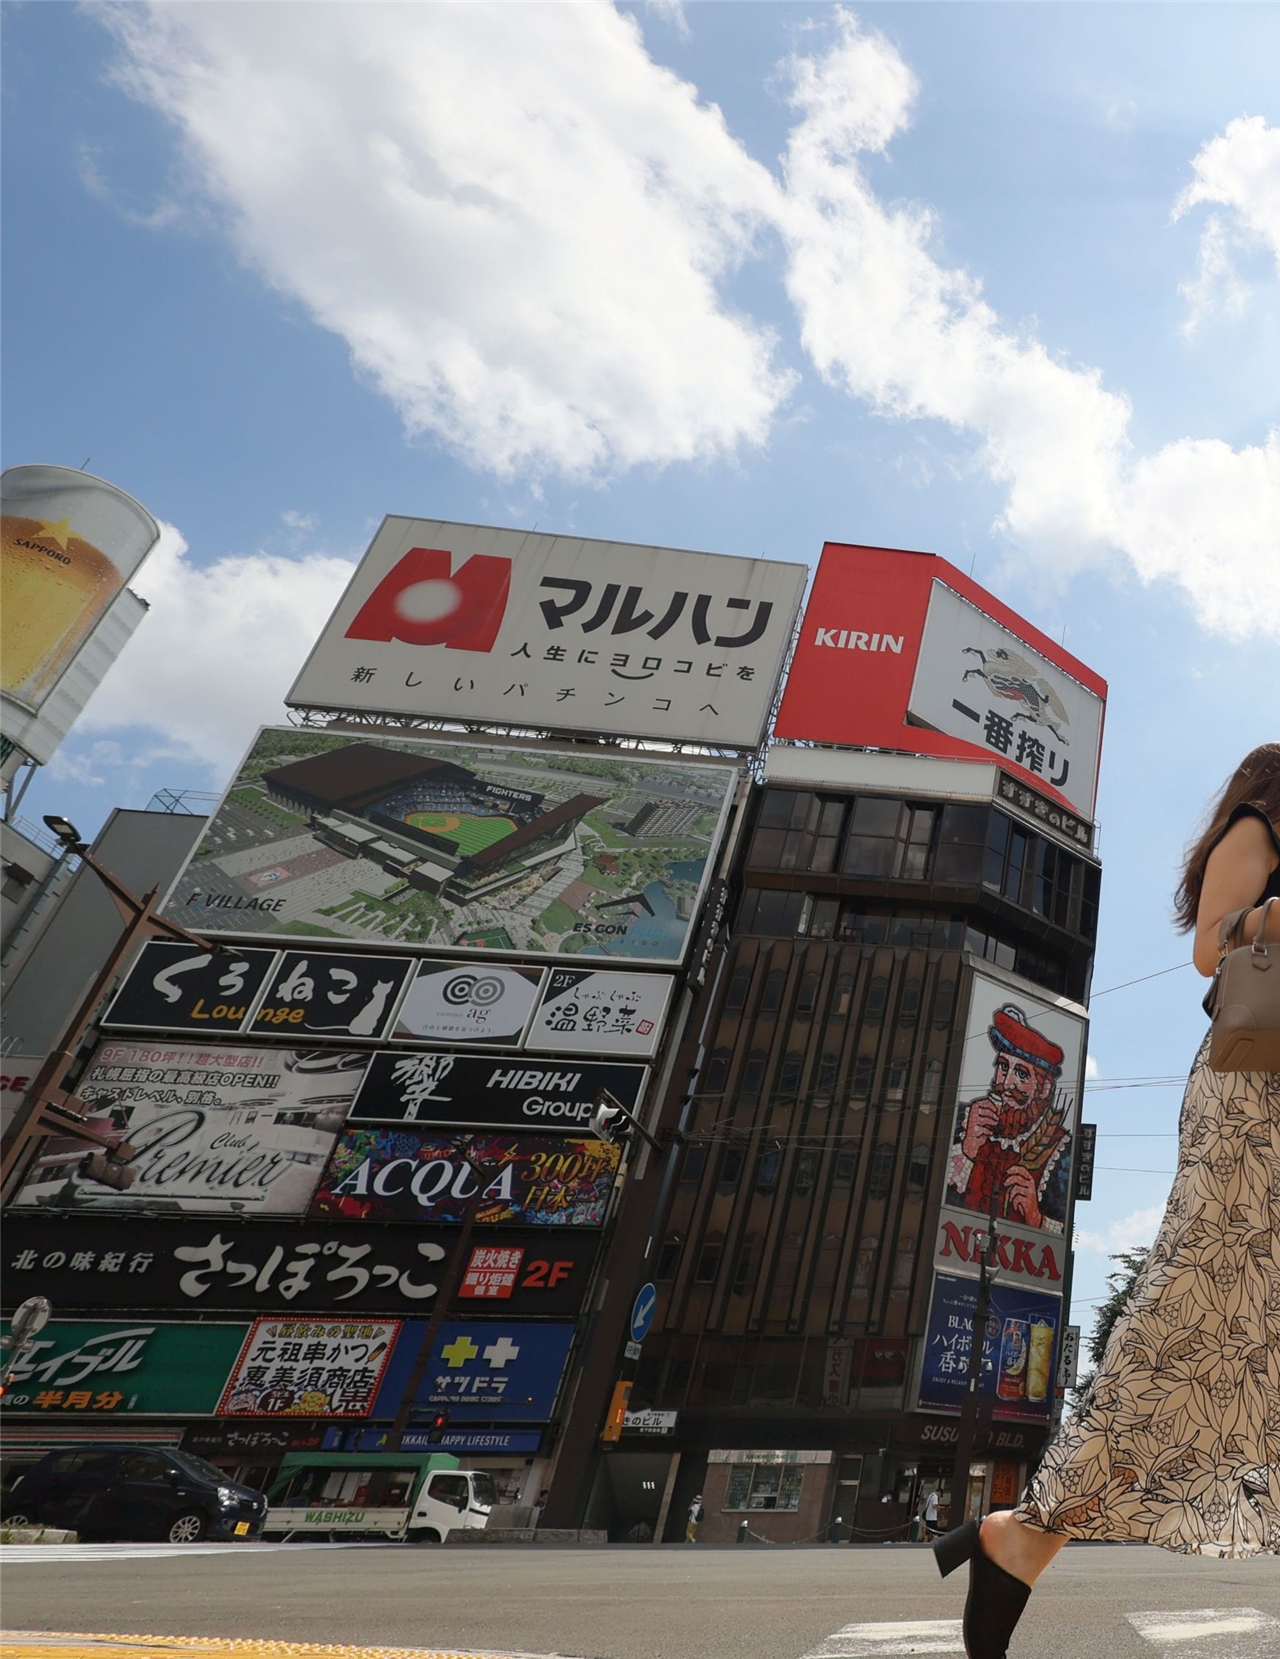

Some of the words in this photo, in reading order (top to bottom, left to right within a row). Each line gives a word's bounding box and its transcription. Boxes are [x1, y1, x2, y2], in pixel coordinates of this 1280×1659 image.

[13, 537, 72, 566] SAPPORO
[538, 576, 774, 649] マルハン
[814, 627, 905, 654] KIRIN
[511, 642, 755, 682] 人生にヨロコビを
[350, 665, 720, 716] 新しいパチンコへ
[952, 698, 1070, 787] 一番搾り
[486, 785, 533, 802] FIGHTERS
[1001, 779, 1089, 843] すすきのビル
[186, 893, 203, 906] F
[203, 894, 287, 912] VILLAGE
[153, 953, 358, 1005] くろねこ
[552, 974, 576, 988] 2F
[190, 999, 306, 1024] Lounge
[466, 1008, 491, 1025] ag
[545, 1003, 637, 1035] 温野菜
[100, 1047, 124, 1063] 9F
[486, 1069, 582, 1092] HIBIKI
[522, 1096, 595, 1121] Group
[330, 1156, 513, 1206] ACQUA
[11, 1250, 154, 1274] 北の味紀行
[939, 1220, 1062, 1281] NIKKA
[173, 1233, 446, 1300] さっぽろっこ
[521, 1259, 574, 1288] 2F
[948, 1315, 974, 1332] BLAC
[250, 1340, 369, 1365] 元祖串かつ
[932, 1333, 994, 1355] ハイボル
[239, 1365, 376, 1390] 恵美須商店
[435, 1376, 509, 1394] サツドラ
[266, 1398, 285, 1411] 1F
[621, 1416, 661, 1426] きのビル
[466, 1435, 511, 1446] LIFESTYLE
[995, 1432, 1025, 1449] BLD.
[305, 1511, 365, 1523] WASHIZU
